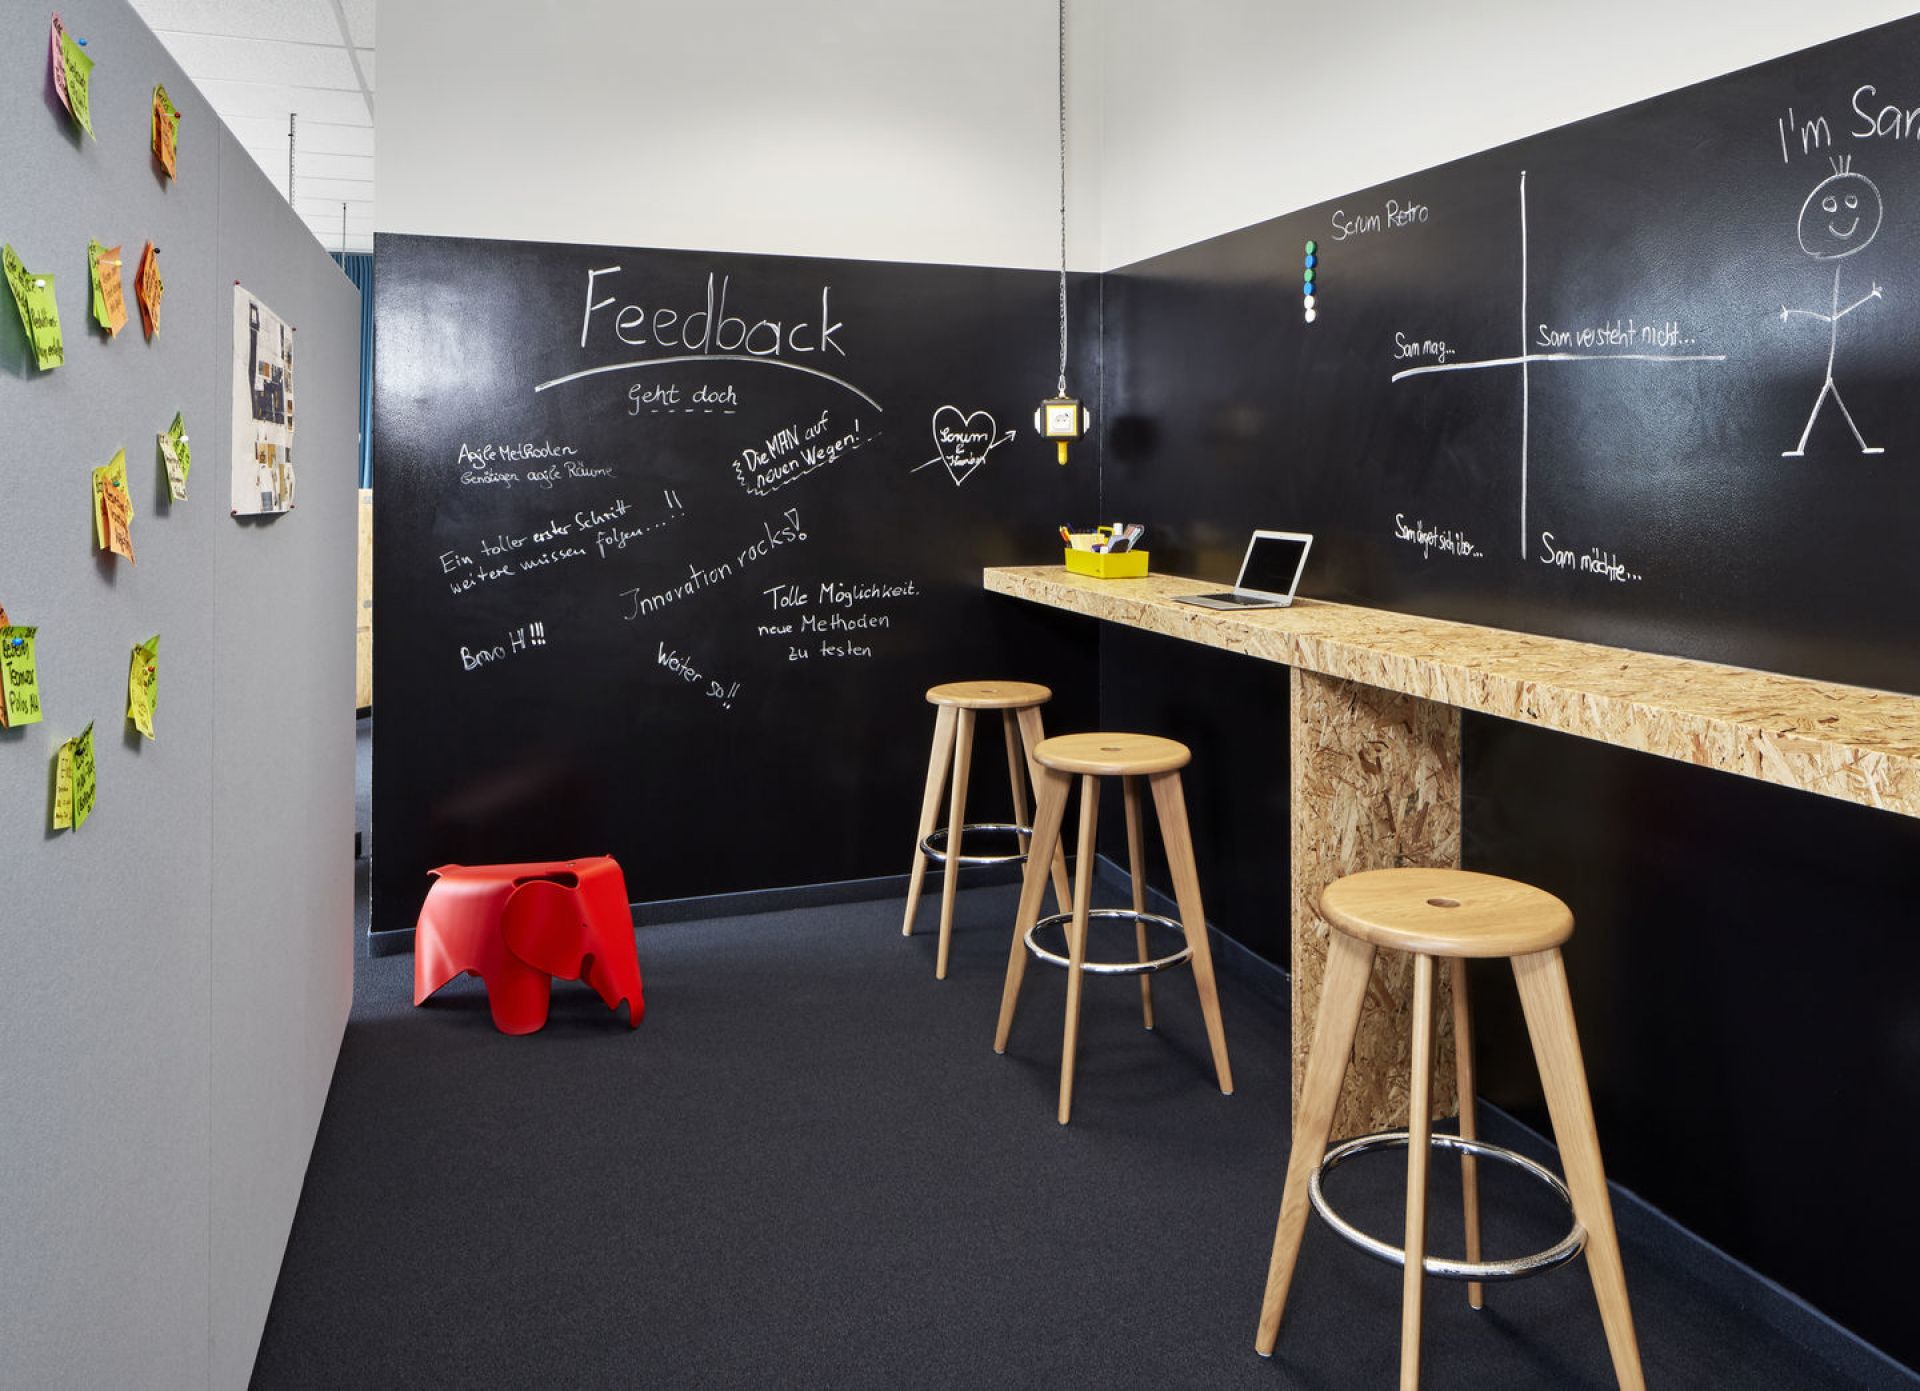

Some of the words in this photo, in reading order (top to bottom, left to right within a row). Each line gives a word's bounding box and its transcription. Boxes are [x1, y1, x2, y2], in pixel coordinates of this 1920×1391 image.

[1779, 107, 1832, 164] I'm
[1331, 210, 1381, 241] Scrum
[1386, 199, 1429, 229] Retro
[580, 266, 847, 357] Feedback
[1394, 331, 1420, 359] Sam
[1536, 323, 1572, 347] Sam
[628, 383, 681, 416] Geht
[692, 384, 738, 406] doch
[743, 448, 769, 472] Die
[766, 424, 800, 460] MAN
[804, 409, 829, 441] auf
[939, 426, 989, 444] Scrum
[457, 442, 496, 470] Agile
[498, 441, 578, 461] Methoden
[526, 465, 562, 489] agile
[563, 460, 616, 479] Räume
[440, 550, 474, 574] Ein
[481, 535, 528, 557] toller
[532, 519, 573, 544] erster
[574, 499, 633, 532] Schritt
[1394, 512, 1416, 544] Sam
[1540, 531, 1576, 571] Sam
[450, 563, 517, 595] weitere
[763, 583, 809, 611] Tolle
[757, 623, 793, 637] neue
[800, 612, 890, 634] Methoden
[459, 645, 506, 672] Bravo
[657, 640, 704, 683] Weiter
[788, 646, 809, 661] zu
[820, 639, 873, 658] testen
